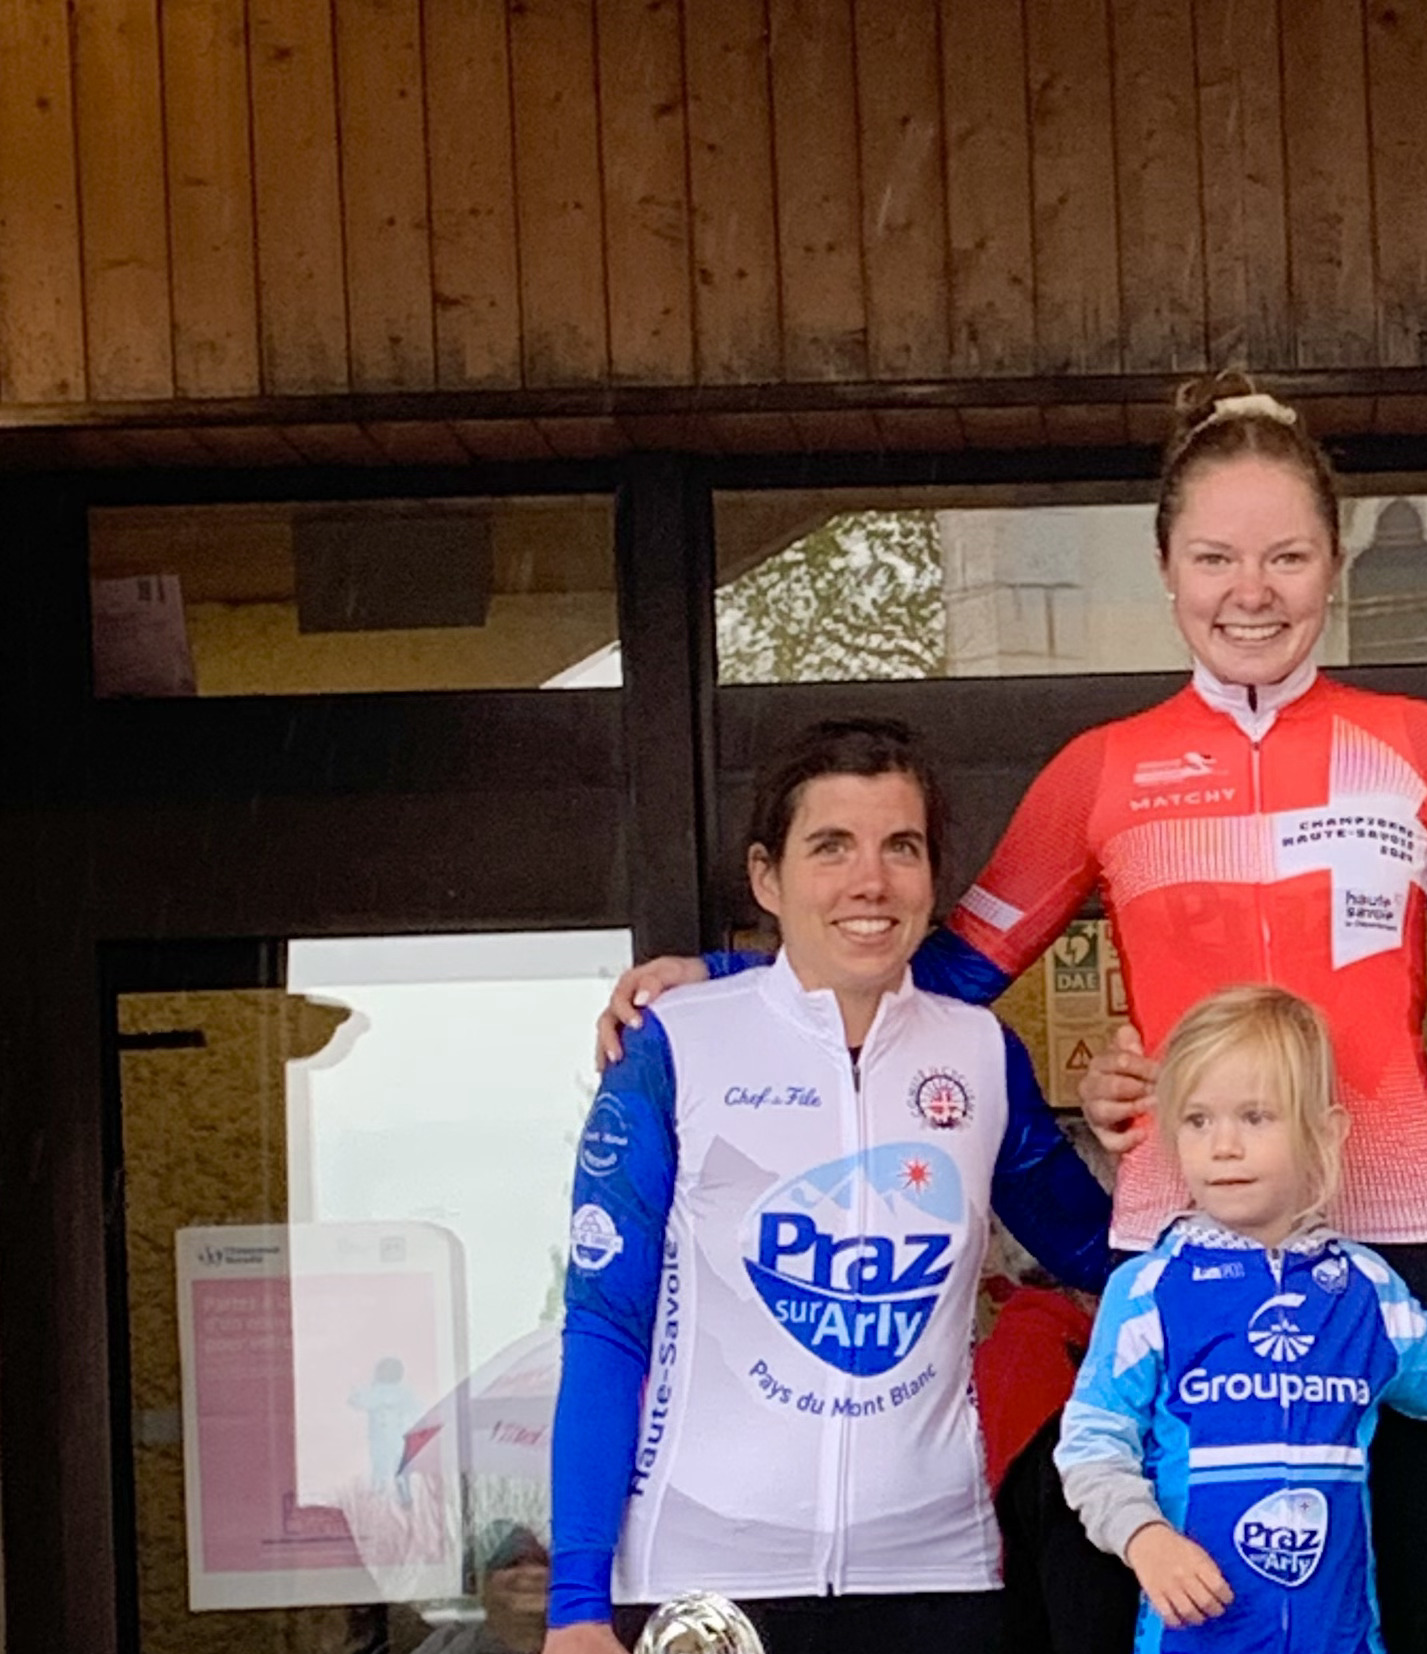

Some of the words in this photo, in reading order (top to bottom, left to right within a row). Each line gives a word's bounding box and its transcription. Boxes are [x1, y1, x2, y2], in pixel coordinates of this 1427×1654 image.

[1129, 788, 1235, 811] MATCHY
[1282, 828, 1414, 851] HAUTE-SAVOIE
[1057, 972, 1097, 990] DAE
[724, 1086, 771, 1109] Chef
[784, 1086, 823, 1108] File
[758, 1212, 955, 1296] Praz
[774, 1298, 824, 1325] sur
[811, 1301, 923, 1358] Arly
[629, 1235, 680, 1498] Haute-Savoie
[748, 1359, 794, 1405] Pays
[797, 1391, 824, 1416] du
[831, 1395, 885, 1418] Mont
[889, 1362, 938, 1407] Blanc
[1179, 1367, 1370, 1409] Groupama
[1244, 1521, 1320, 1552] Praz
[1264, 1552, 1311, 1579] Arly
